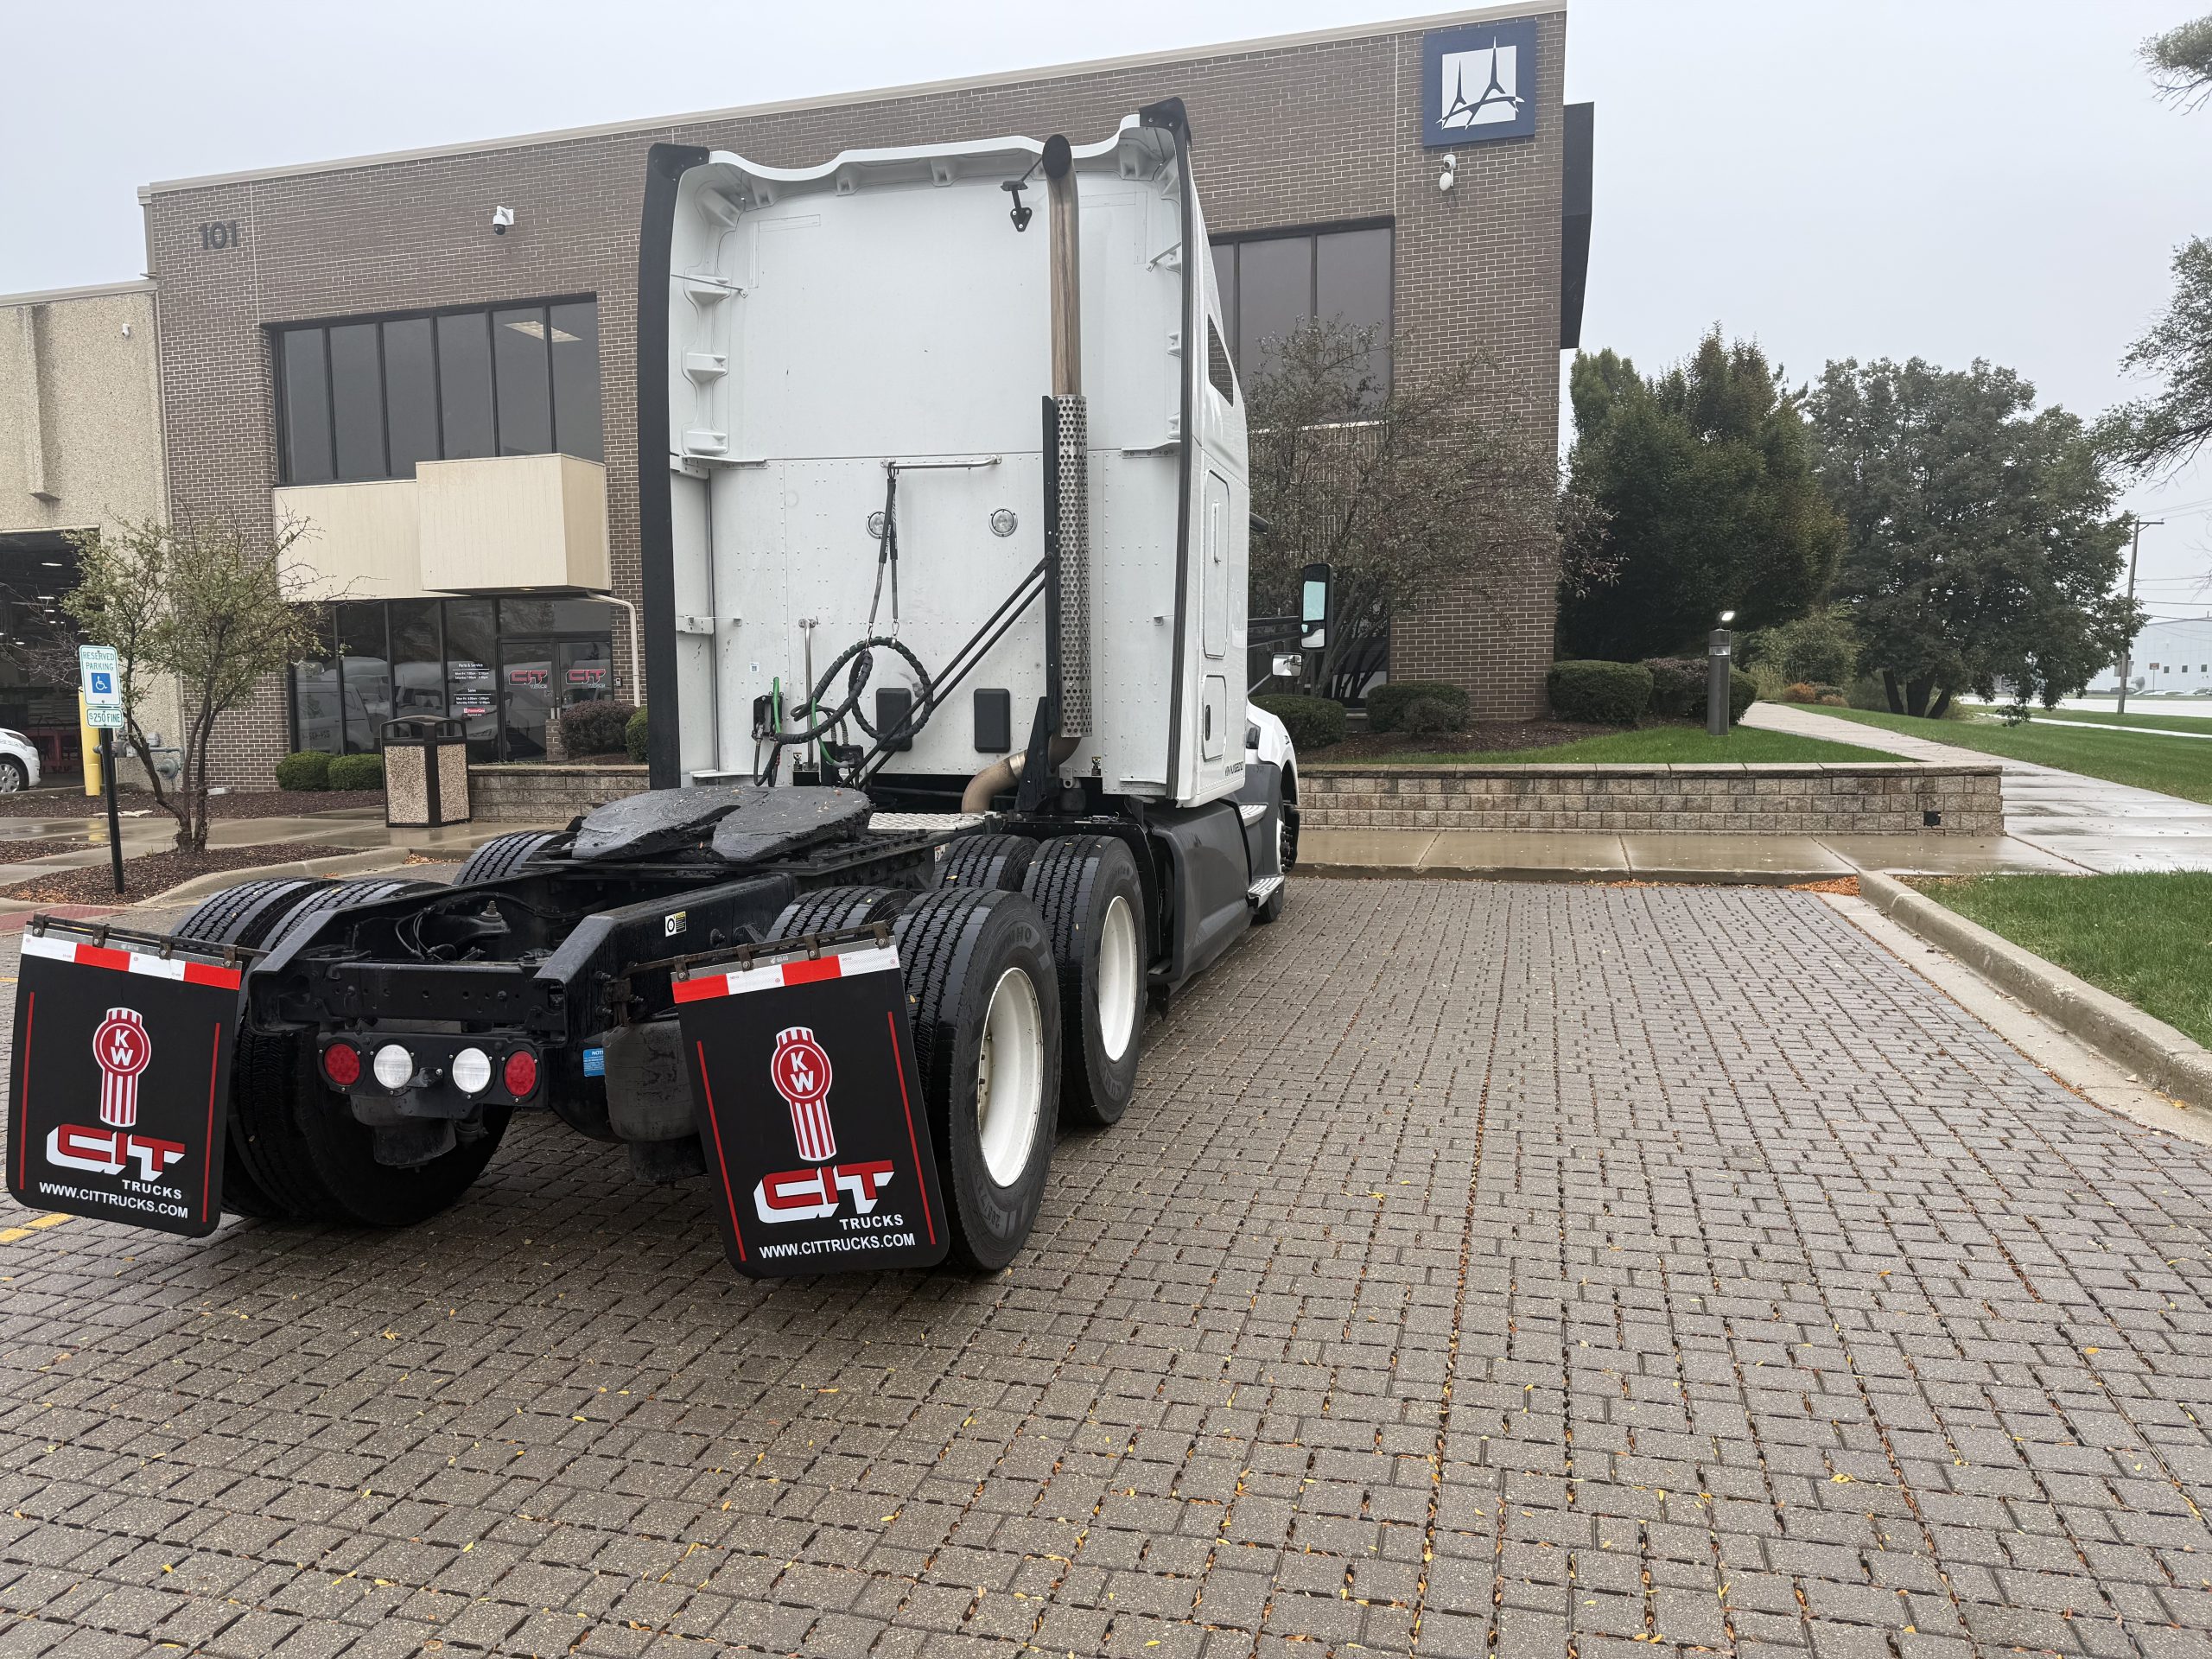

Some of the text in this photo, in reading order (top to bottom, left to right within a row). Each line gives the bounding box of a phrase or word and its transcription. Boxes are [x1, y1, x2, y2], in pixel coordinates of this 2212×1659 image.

[199, 219, 237, 250] 101
[83, 652, 114, 660] RESERVED
[86, 662, 114, 671] PARKING
[509, 670, 548, 685] CIT
[566, 669, 606, 685] CIT
[89, 712, 120, 722] $250 FINE
[47, 1124, 186, 1181] CIT
[122, 1179, 182, 1200] TRUCKS
[753, 1160, 894, 1224] CIT
[39, 1181, 188, 1219] WWW.CITTRUCKS.COM
[840, 1214, 904, 1230] TRUCKS
[760, 1232, 916, 1259] WWW.CITTRUCKS.COM
